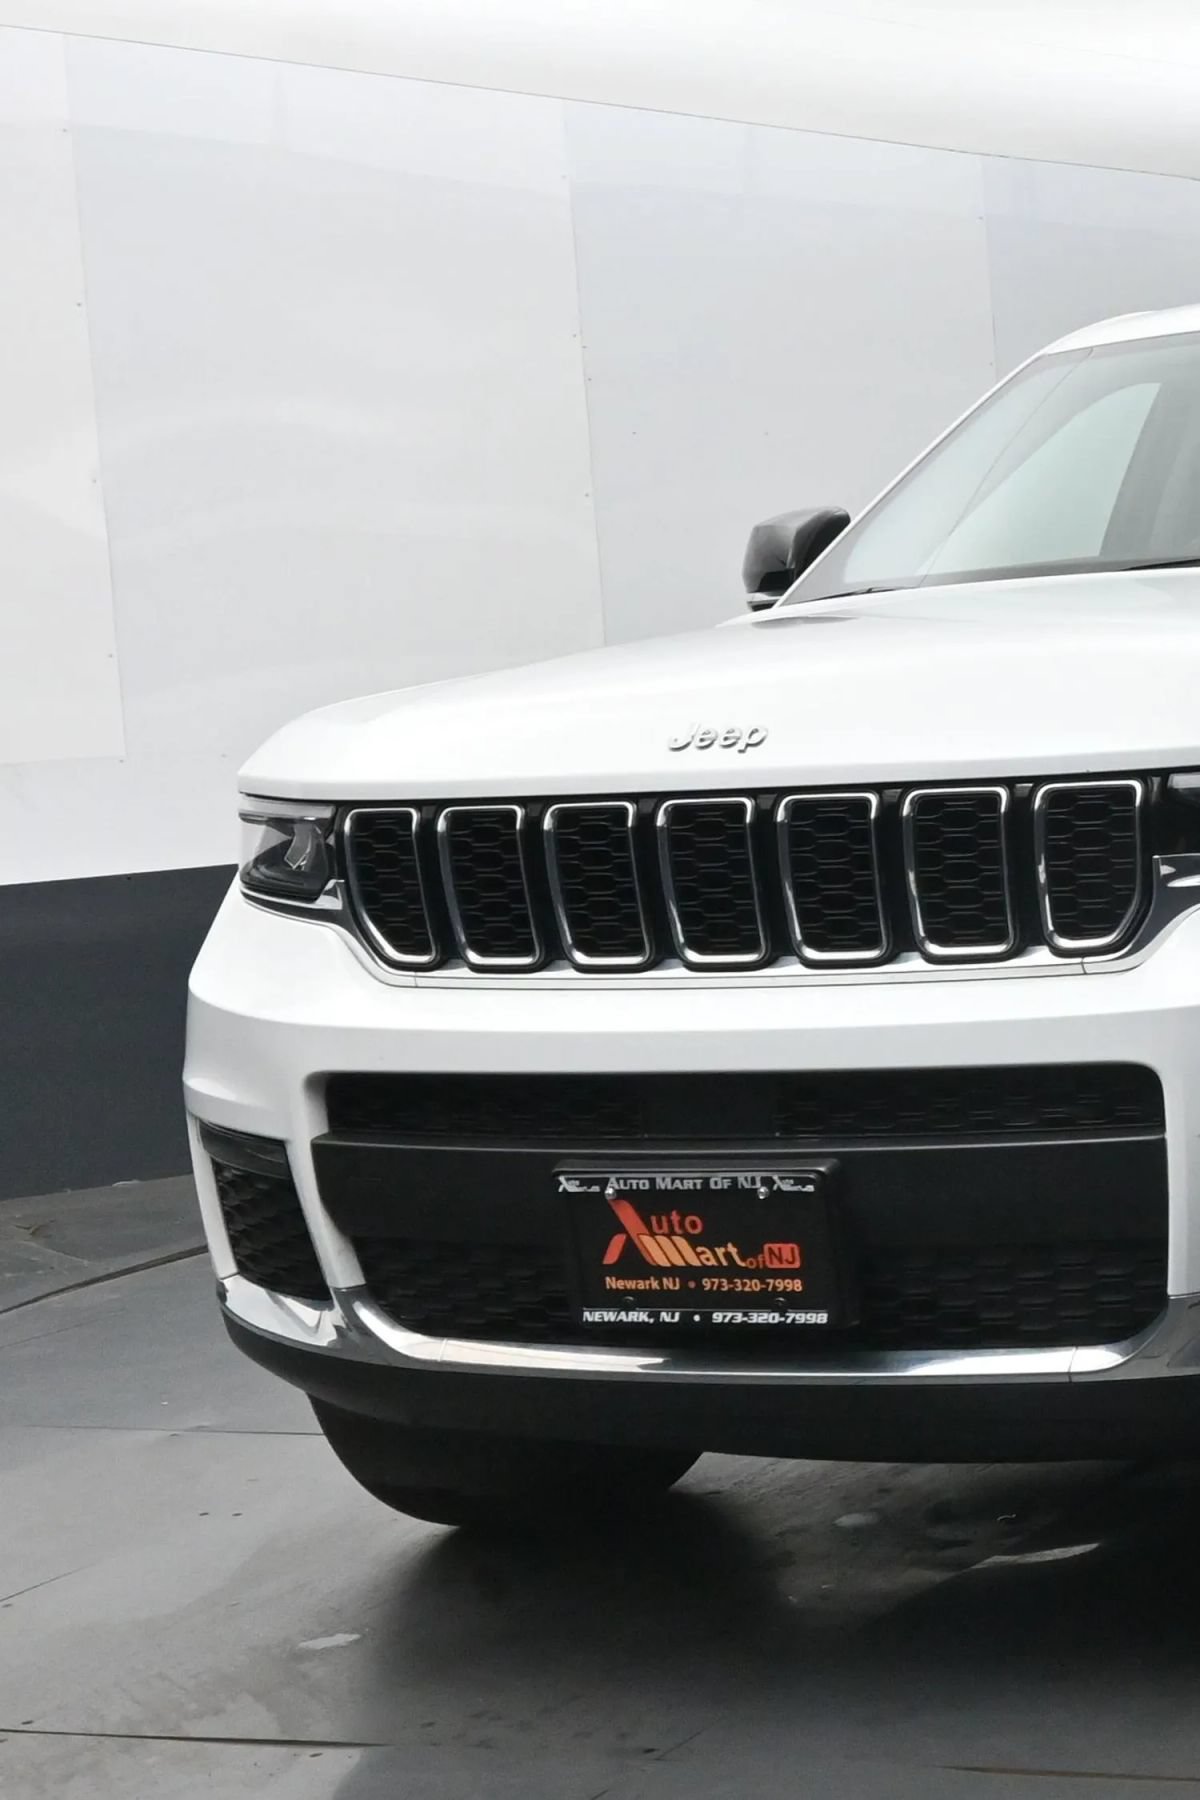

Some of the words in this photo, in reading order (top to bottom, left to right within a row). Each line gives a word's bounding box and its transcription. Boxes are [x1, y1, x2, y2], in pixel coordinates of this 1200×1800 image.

[668, 722, 769, 753] Jeep
[738, 1176, 761, 1190] NJ
[603, 1199, 704, 1265] Auto
[746, 1254, 766, 1269] of
[768, 1246, 798, 1266] NJ
[605, 1276, 660, 1291] Newark
[663, 1277, 681, 1291] NJ
[701, 1278, 803, 1293] 973-320-7998
[582, 1311, 654, 1324] NEWARK,
[659, 1311, 681, 1323] NJ
[711, 1312, 829, 1324] 973-320-7998
